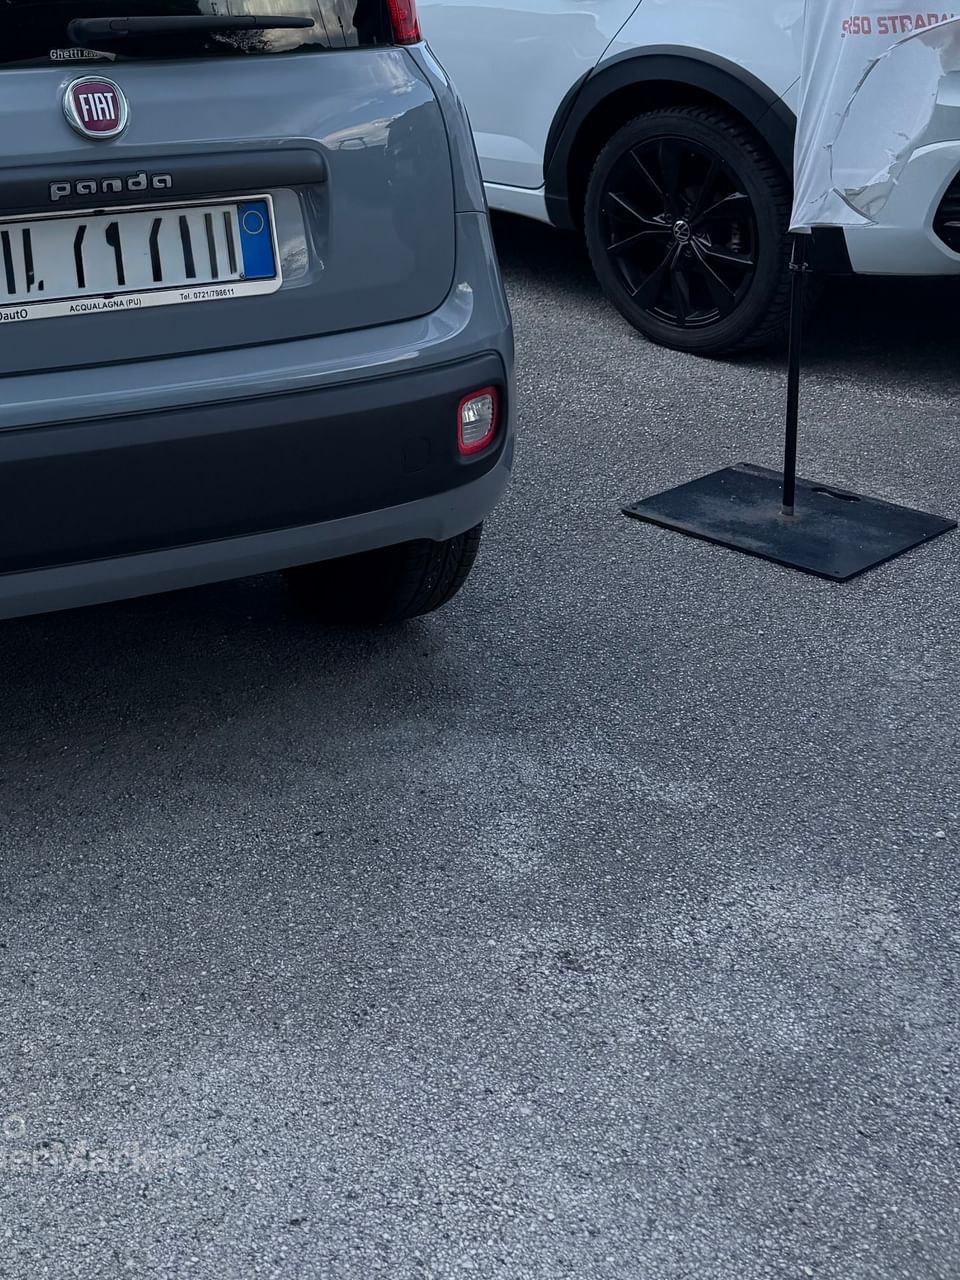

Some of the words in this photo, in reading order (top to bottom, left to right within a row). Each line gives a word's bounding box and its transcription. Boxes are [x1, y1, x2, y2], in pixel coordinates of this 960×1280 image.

[78, 92, 116, 122] FIAT
[49, 171, 173, 202] panda
[69, 300, 125, 313] ACQUALAGNA
[125, 297, 142, 308] (PU)
